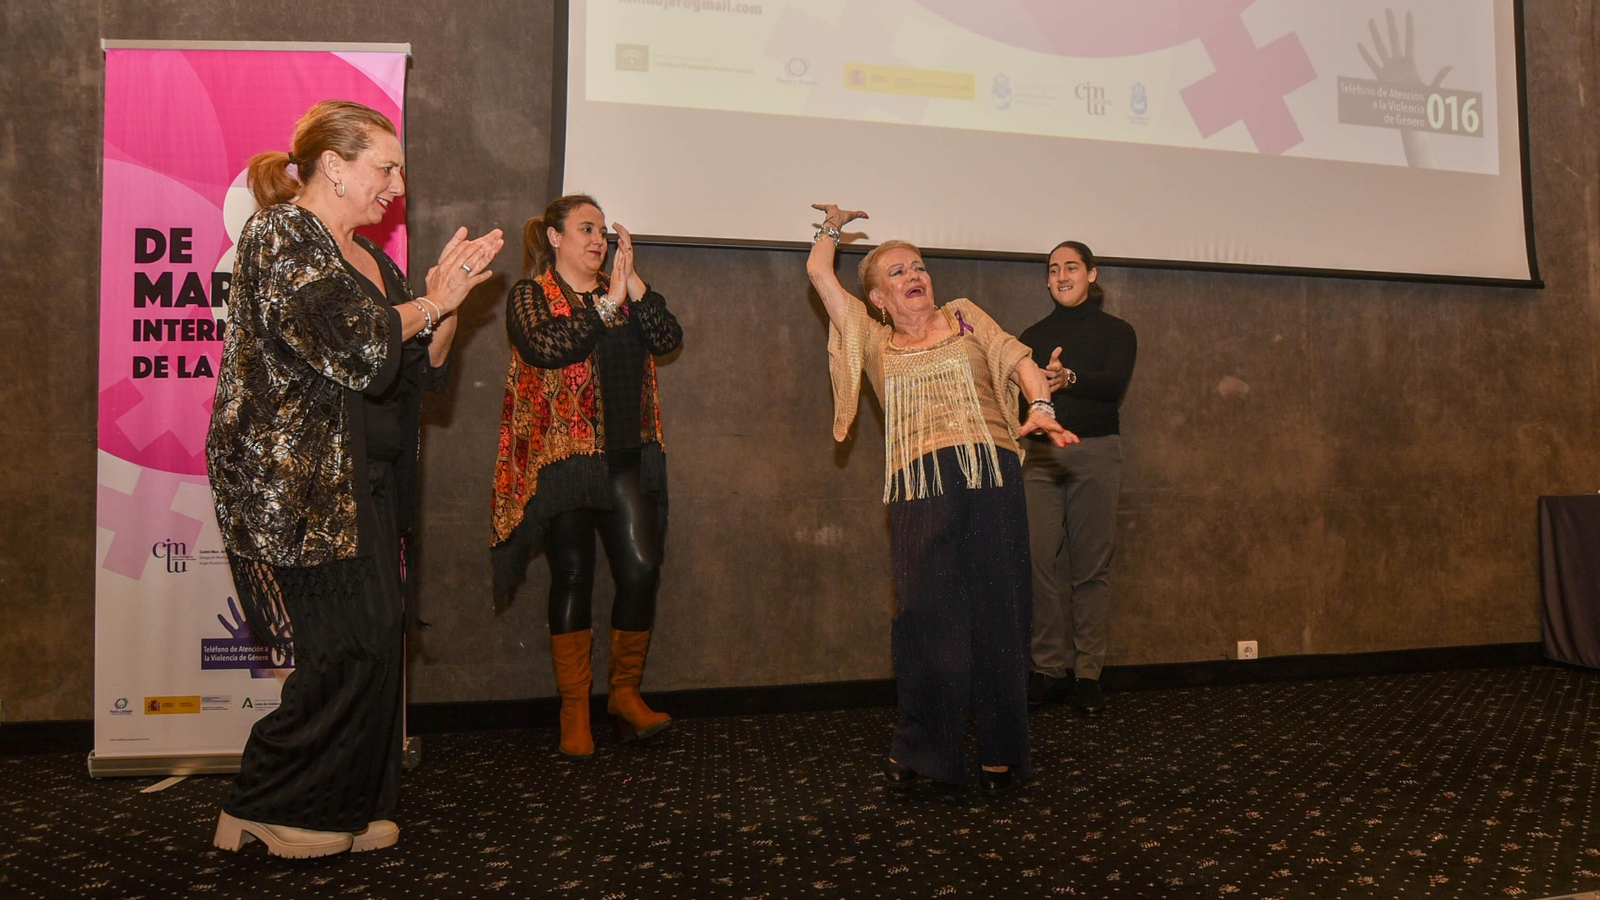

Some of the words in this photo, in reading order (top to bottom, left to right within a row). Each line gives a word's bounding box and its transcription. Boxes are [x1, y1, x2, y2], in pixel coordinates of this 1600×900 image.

[1341, 81, 1376, 97] Teléfono
[1377, 86, 1387, 98] de
[1389, 88, 1425, 102] Atención
[1372, 101, 1378, 110] a
[1379, 99, 1387, 110] la
[1388, 100, 1425, 115] Violencia
[1426, 93, 1480, 133] 016
[1384, 112, 1394, 123] de
[1395, 113, 1425, 128] Género
[134, 227, 193, 264] DE
[134, 272, 233, 308] MAR
[132, 319, 228, 342] INTERN
[132, 355, 169, 379] DE
[178, 355, 215, 379] LA
[203, 645, 229, 653] Teléfono
[210, 654, 238, 662] Violencia
[247, 653, 269, 661] Género
